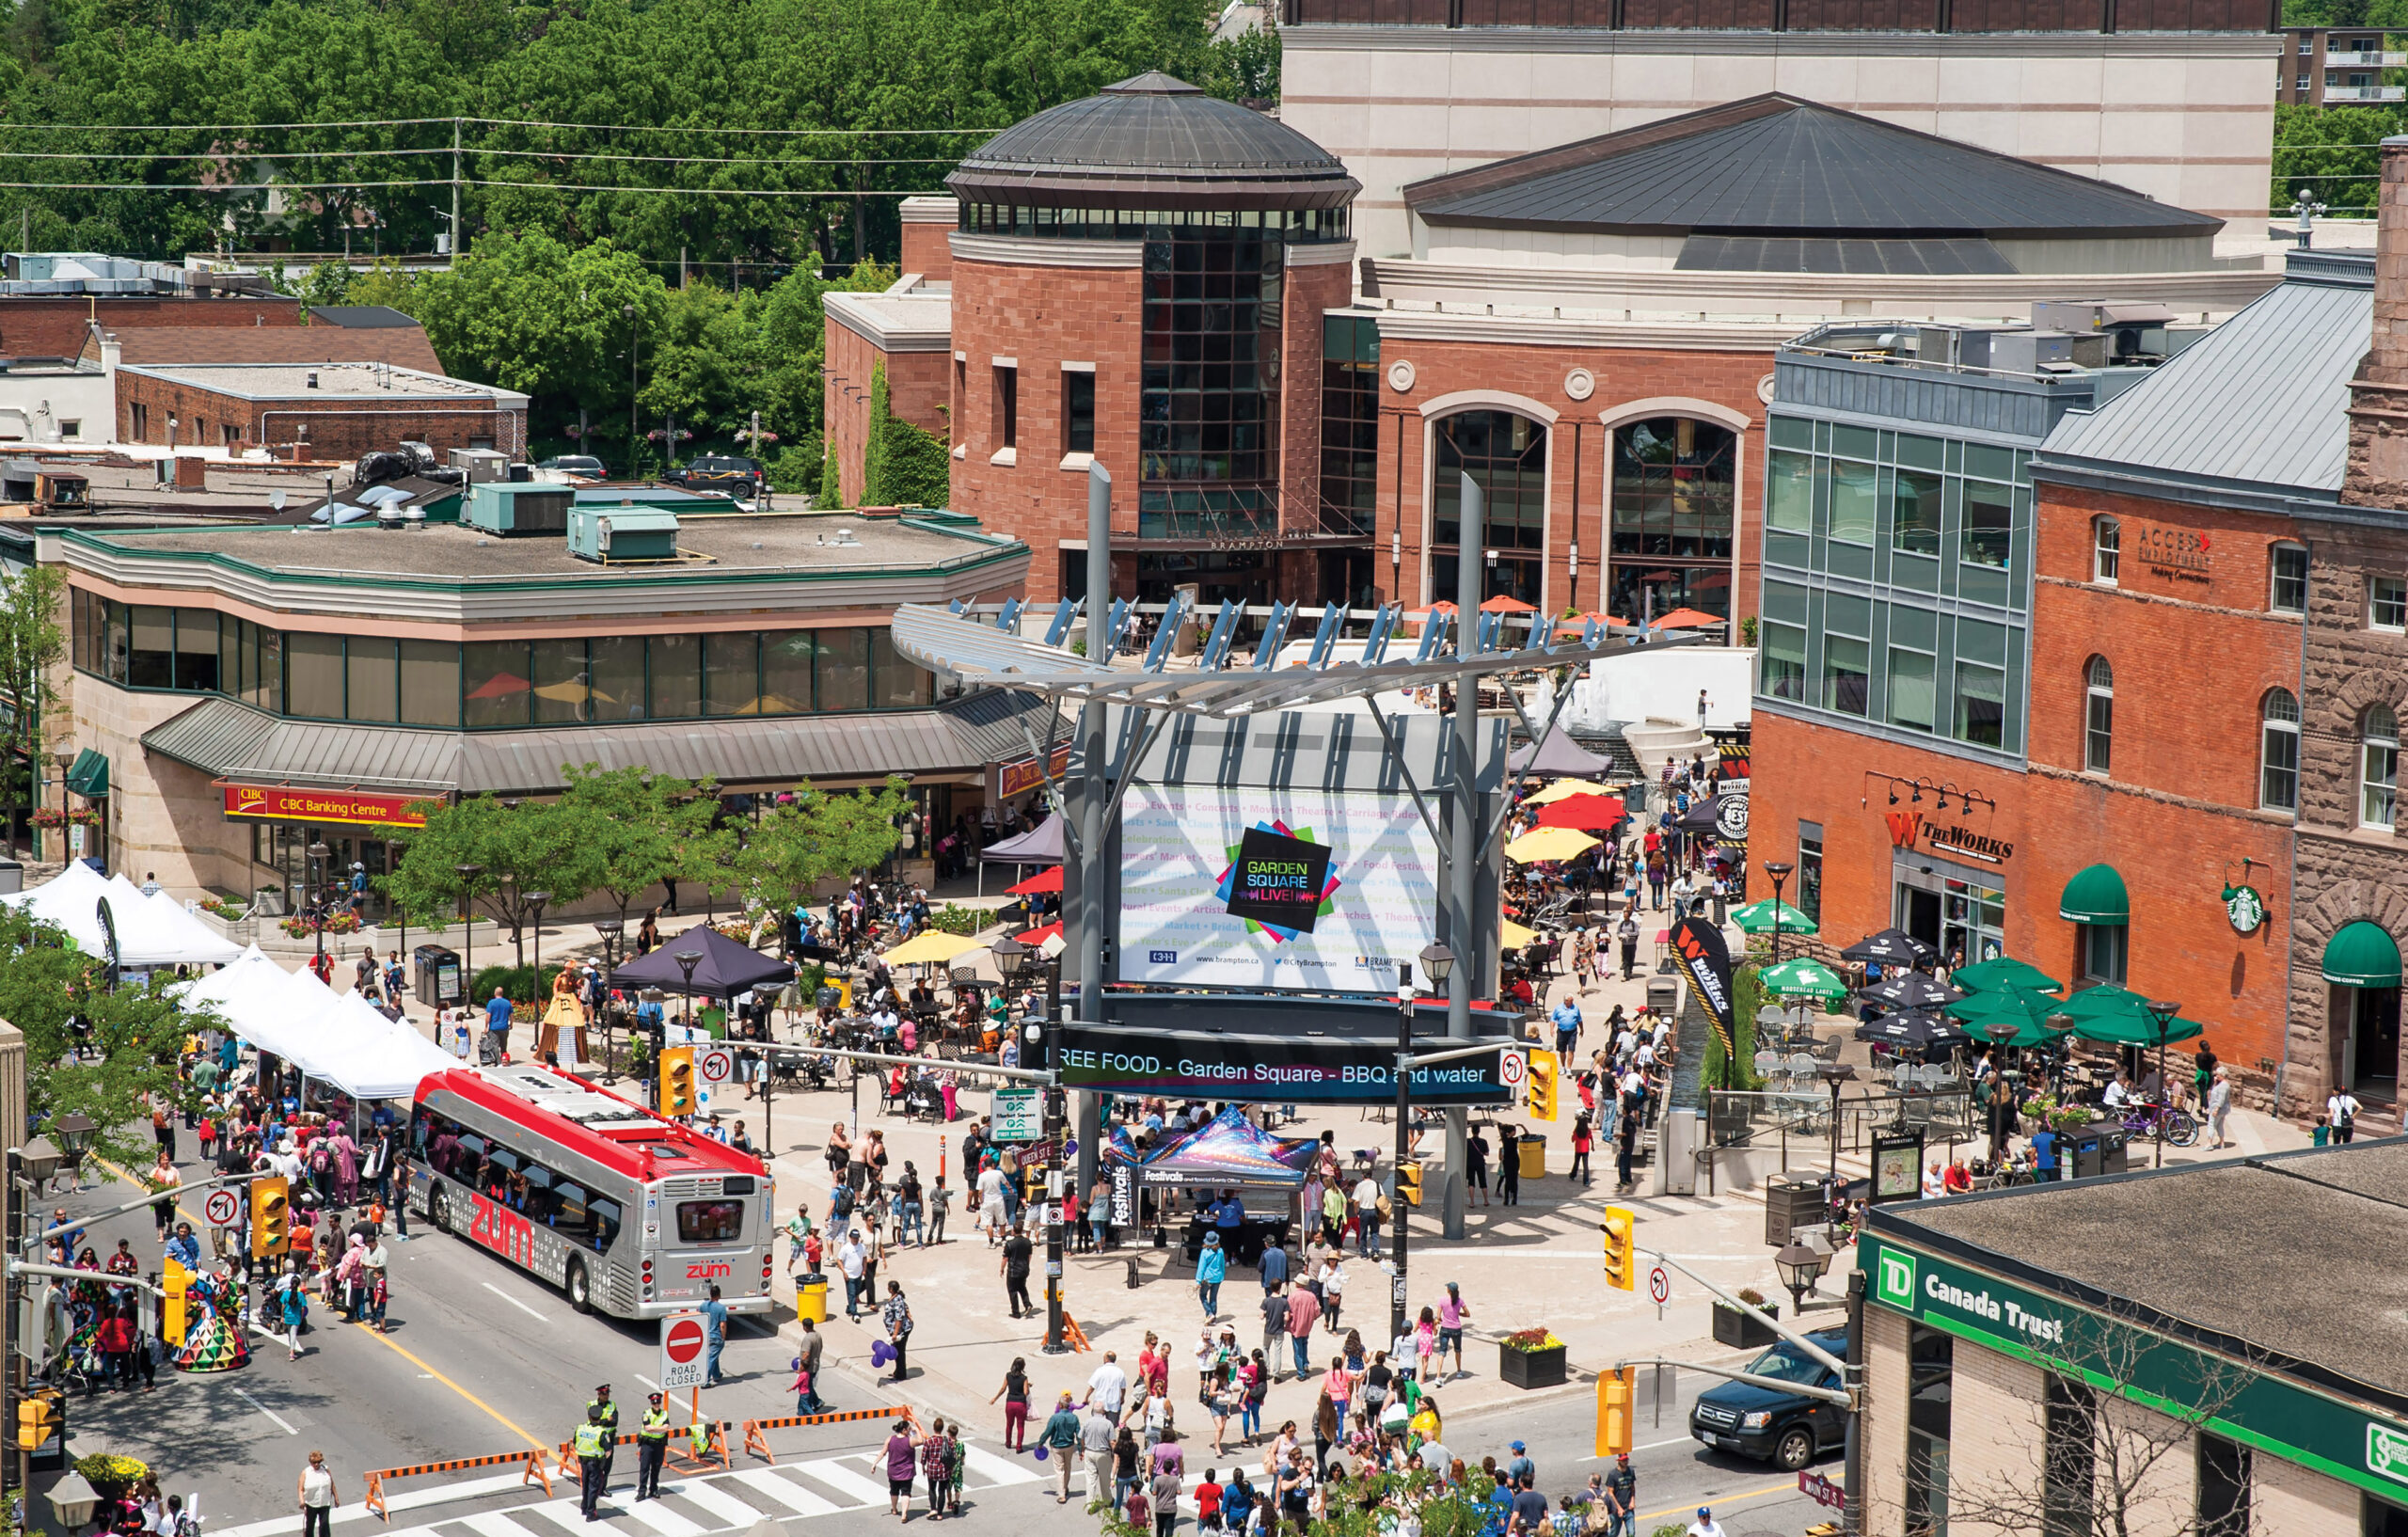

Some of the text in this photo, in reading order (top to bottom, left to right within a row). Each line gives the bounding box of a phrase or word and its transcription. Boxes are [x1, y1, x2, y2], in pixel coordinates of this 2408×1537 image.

[1211, 541, 1284, 550] BRAMPTON
[240, 788, 265, 800] CIBC
[279, 798, 387, 817] CIBC Banking Centre
[1150, 800, 1184, 811] Events
[1196, 802, 1239, 813] Concerts
[1249, 804, 1286, 815] Movies
[1296, 806, 1335, 816] Theatre
[1346, 808, 1388, 819] Carriage
[1392, 810, 1419, 819] Rides
[1160, 852, 1196, 863] Market
[1364, 860, 1387, 869] Food
[1391, 861, 1435, 871] Festivals
[1247, 862, 1307, 876] GARDEN
[1247, 875, 1307, 888] SQUARE
[1149, 903, 1182, 913] Events
[1385, 912, 1424, 923] Theatre
[1196, 955, 1259, 965] www.brampton.ca
[1283, 958, 1337, 968] @CityBrampton
[1046, 1047, 1096, 1069] REE
[1101, 1053, 1160, 1074] FOOD
[1178, 1059, 1247, 1080] Garden
[1254, 1064, 1323, 1085] Square
[1342, 1066, 1387, 1084] BBQ
[1434, 1065, 1486, 1083] water
[1021, 1146, 1052, 1165] QUEEN ST E
[1145, 1170, 1183, 1182] Festivals
[1111, 1165, 1128, 1227] Festivals
[1882, 1257, 2064, 1344] TD Canada Trust
[665, 1373, 702, 1386] CLOSED
[671, 1365, 697, 1376] ROAD
[1805, 1479, 1838, 1505] MAIN ST S
